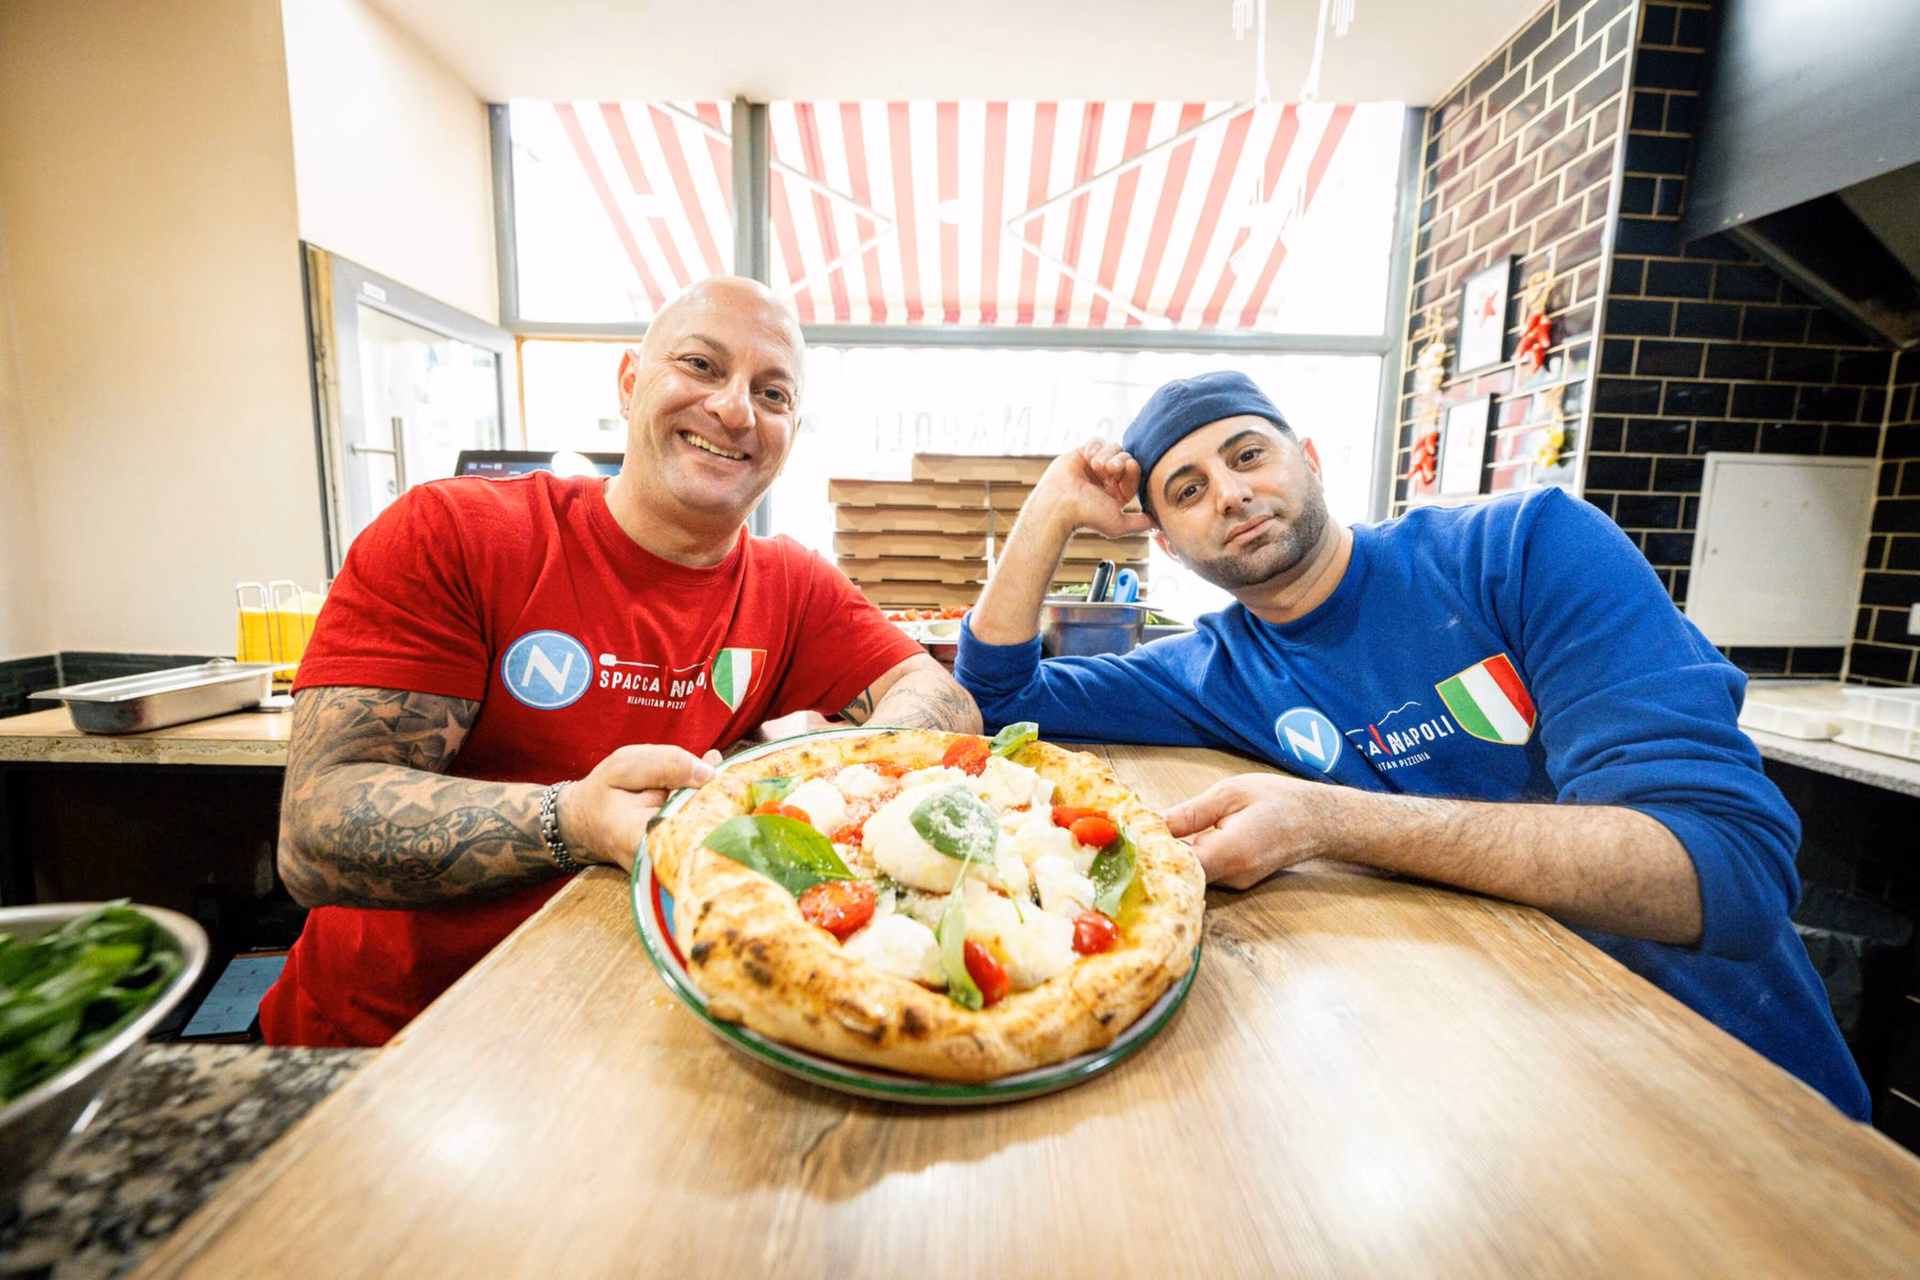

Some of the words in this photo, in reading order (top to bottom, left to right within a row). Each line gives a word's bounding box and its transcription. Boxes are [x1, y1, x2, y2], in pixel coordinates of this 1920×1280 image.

[521, 644, 574, 695] N
[599, 669, 660, 693] SPACCA
[627, 696, 664, 709] NEAPOLITAN
[666, 700, 687, 711] PIZZ
[1284, 720, 1326, 762] N
[1386, 714, 1456, 756] NAPOLI
[1400, 751, 1431, 768] PIZZERIA
